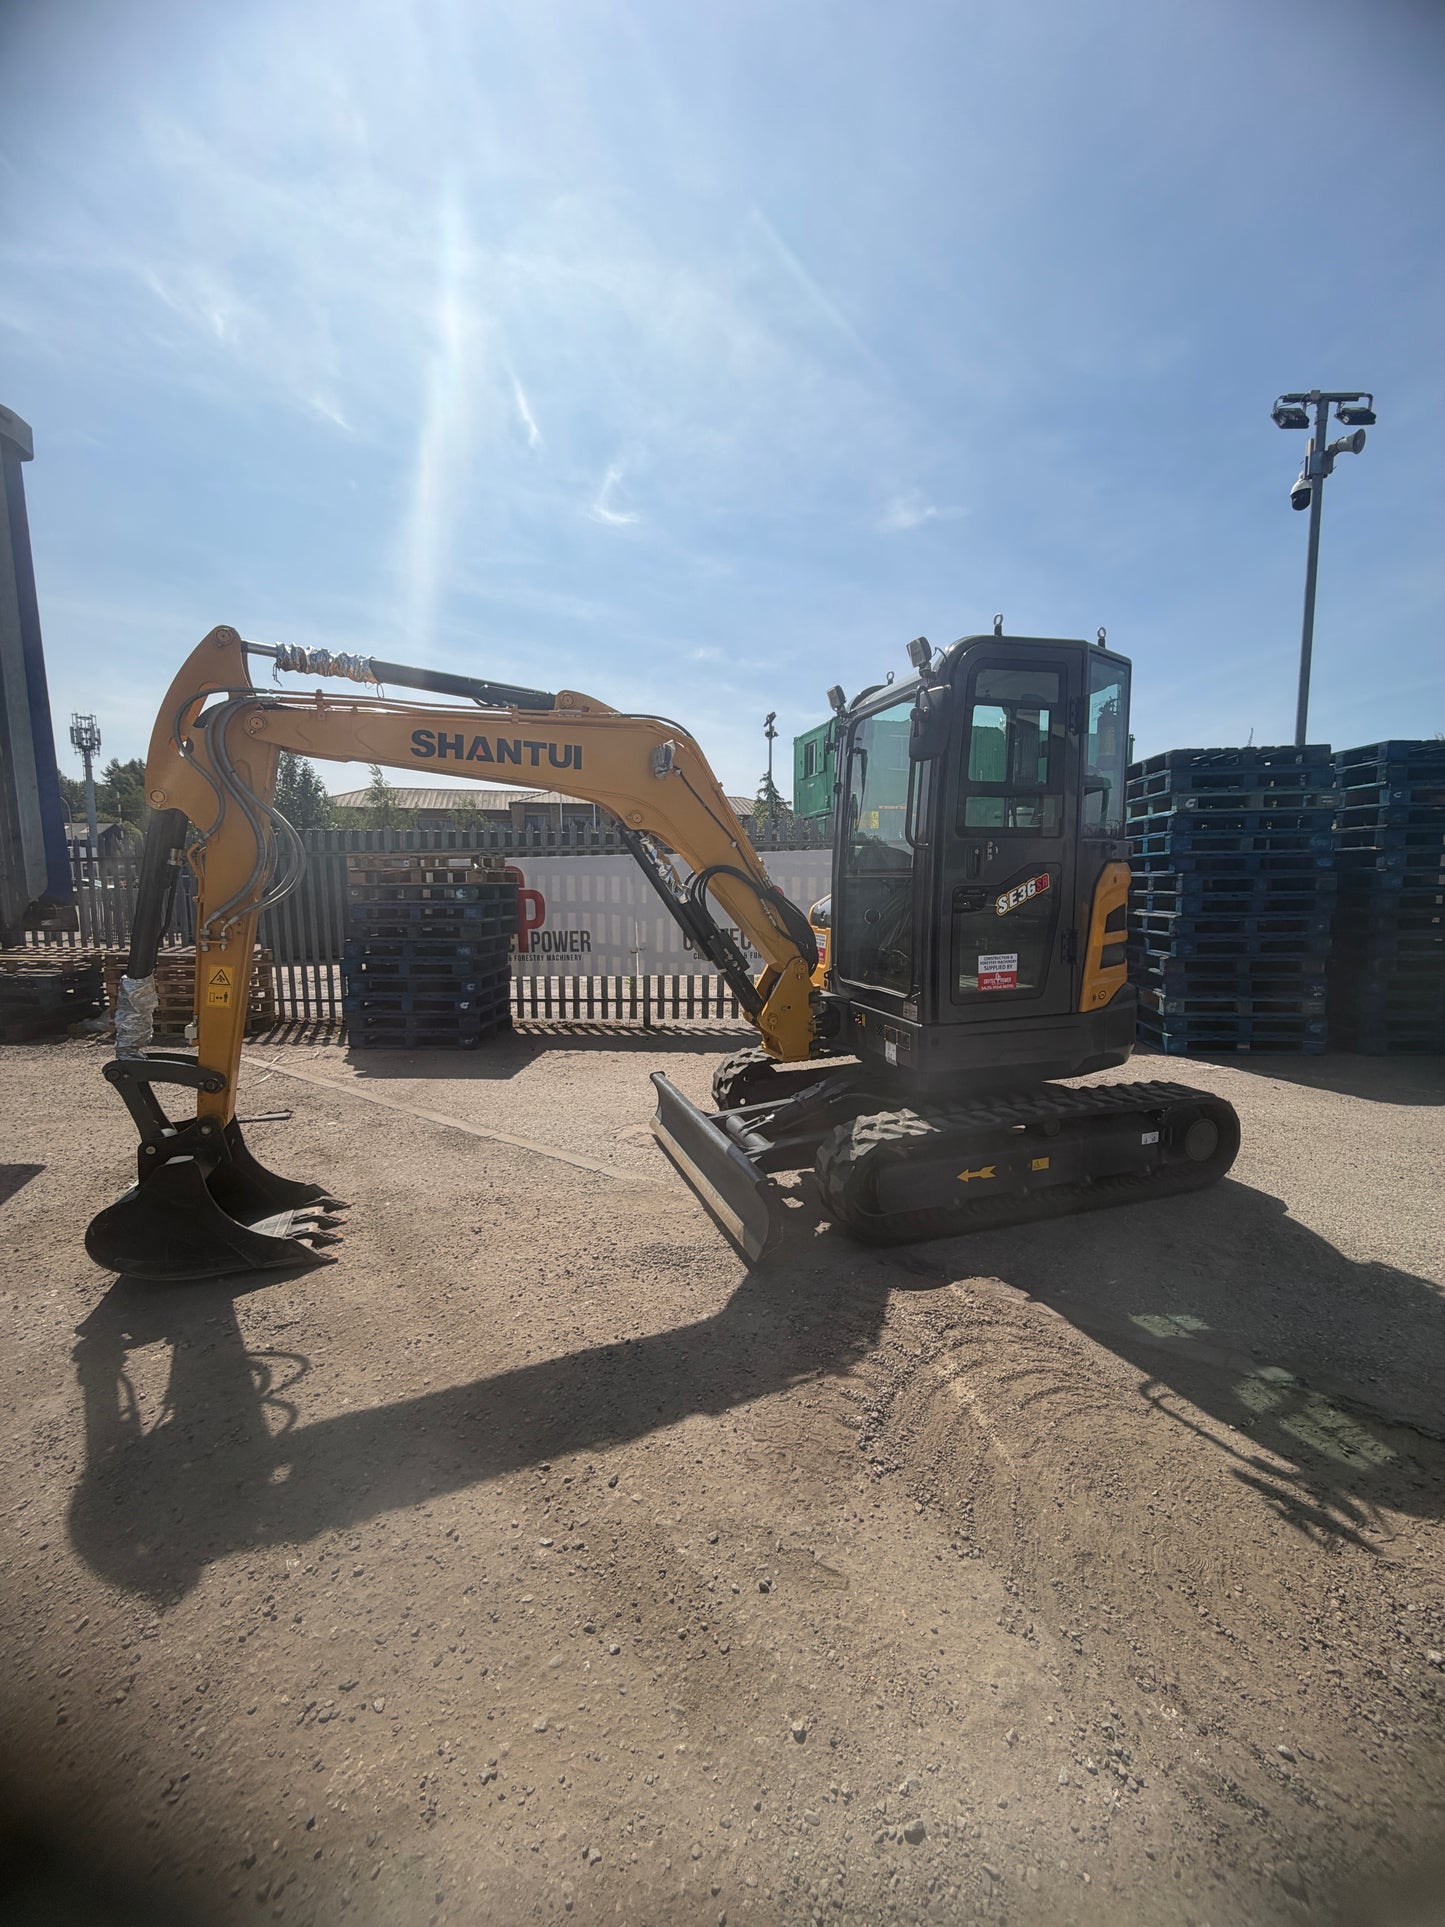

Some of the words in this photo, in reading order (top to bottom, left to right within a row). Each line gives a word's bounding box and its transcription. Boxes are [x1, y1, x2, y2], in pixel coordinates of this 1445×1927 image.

[410, 729, 583, 770] SHANTUI
[530, 930, 592, 953] POWER
[514, 954, 544, 962] FORESTRY
